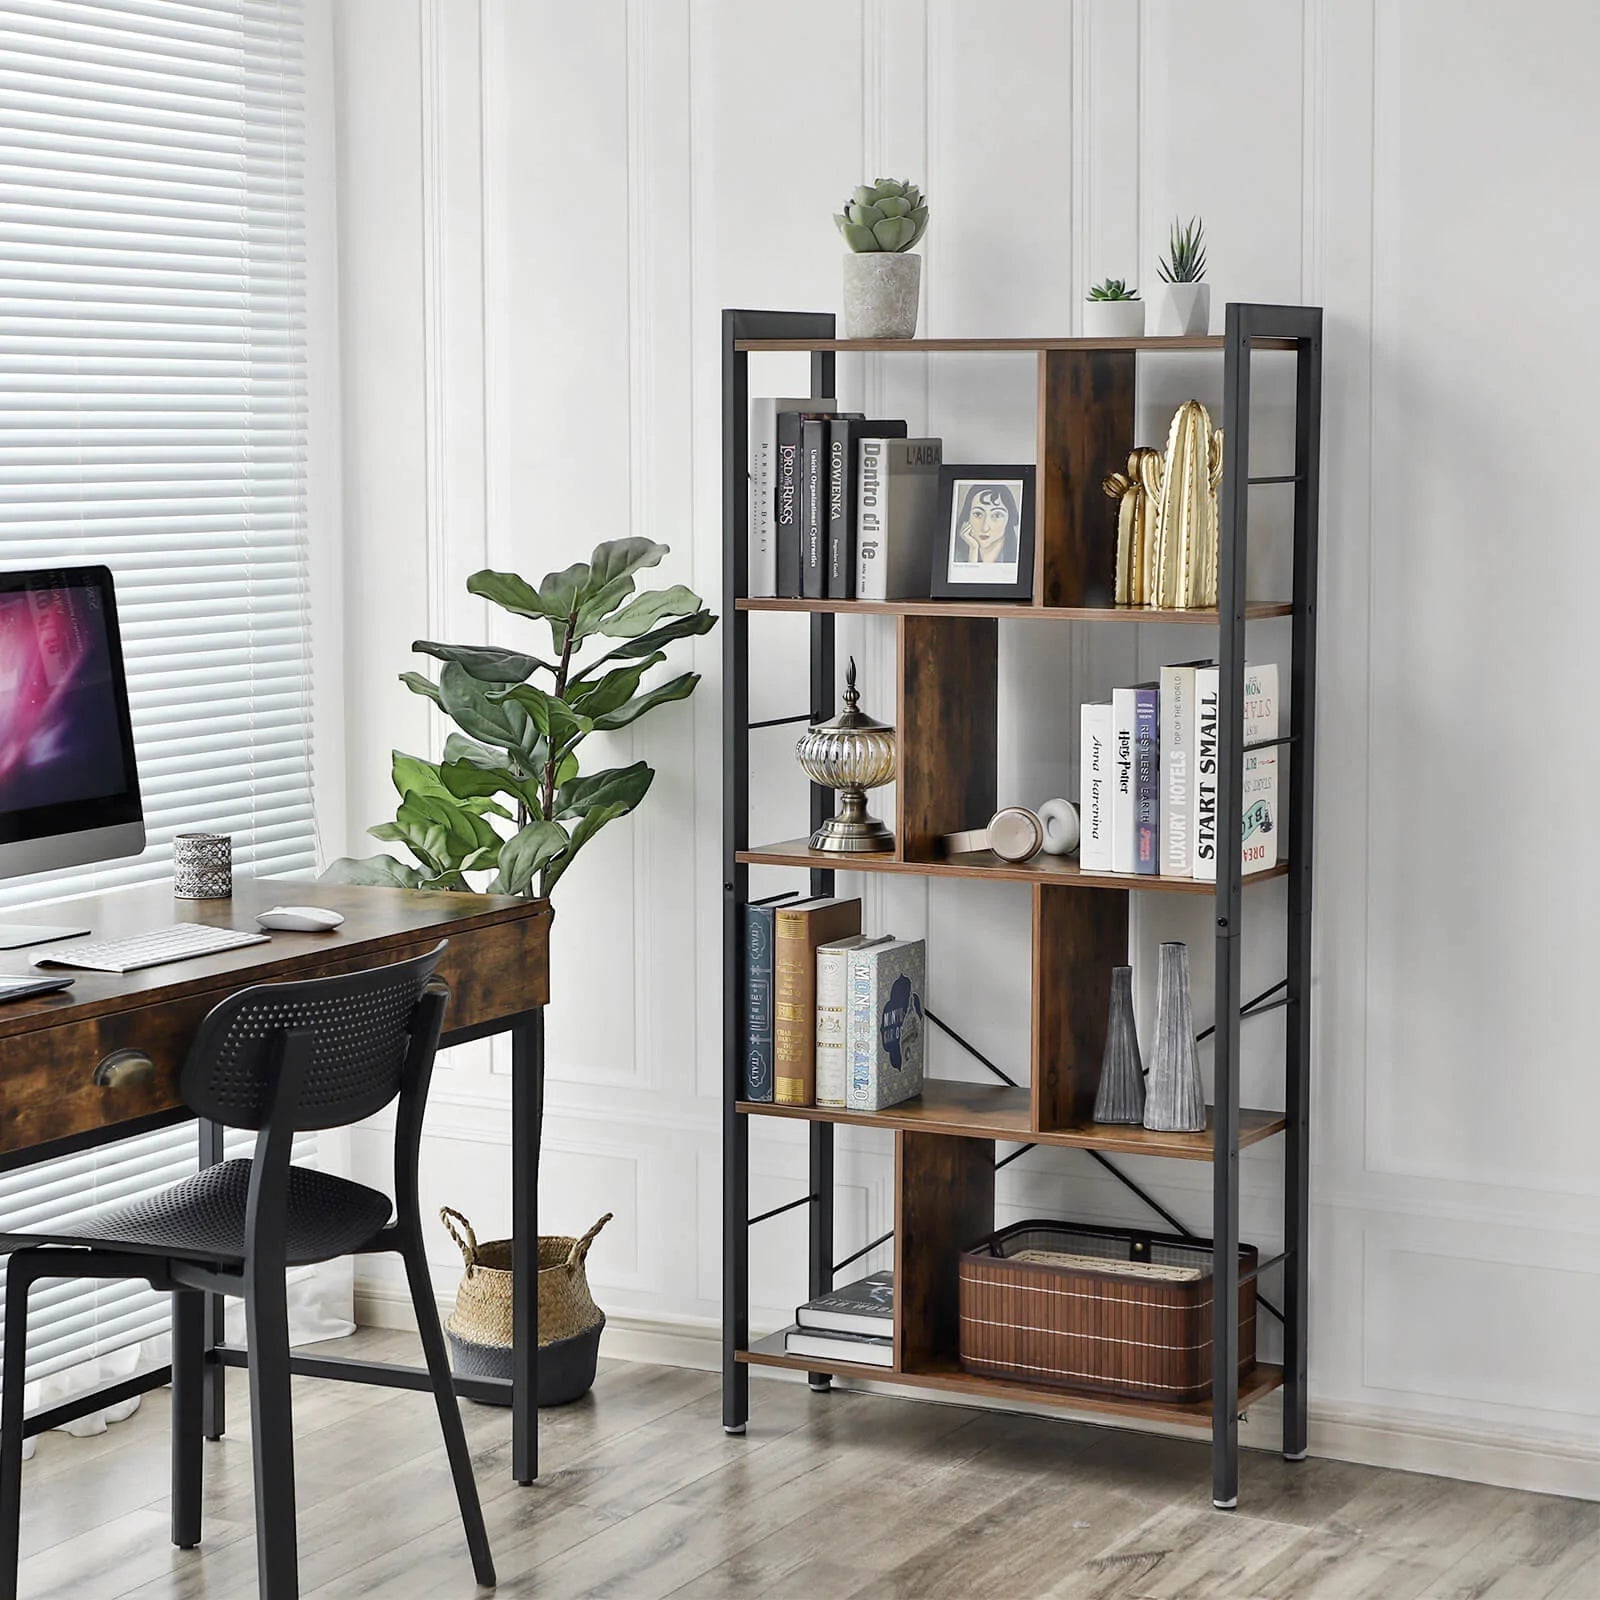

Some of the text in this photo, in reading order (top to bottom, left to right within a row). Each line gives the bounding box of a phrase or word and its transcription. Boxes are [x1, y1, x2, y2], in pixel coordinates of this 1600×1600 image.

[780, 444, 796, 476] LORD
[832, 441, 842, 521] GLOWIENKA
[780, 485, 795, 525] RINGS
[861, 443, 881, 560] Dentro di te
[1174, 676, 1183, 745] TOP OF THE WORLD
[1140, 724, 1149, 782] RESTLESS
[1198, 691, 1218, 860] START SMALL
[1140, 787, 1150, 823] EARTH
[1169, 750, 1187, 868] LUXURY HOTELS
[1242, 845, 1265, 863] DREA
[751, 929, 760, 954] ITALY
[751, 1057, 760, 1081] ITALY
